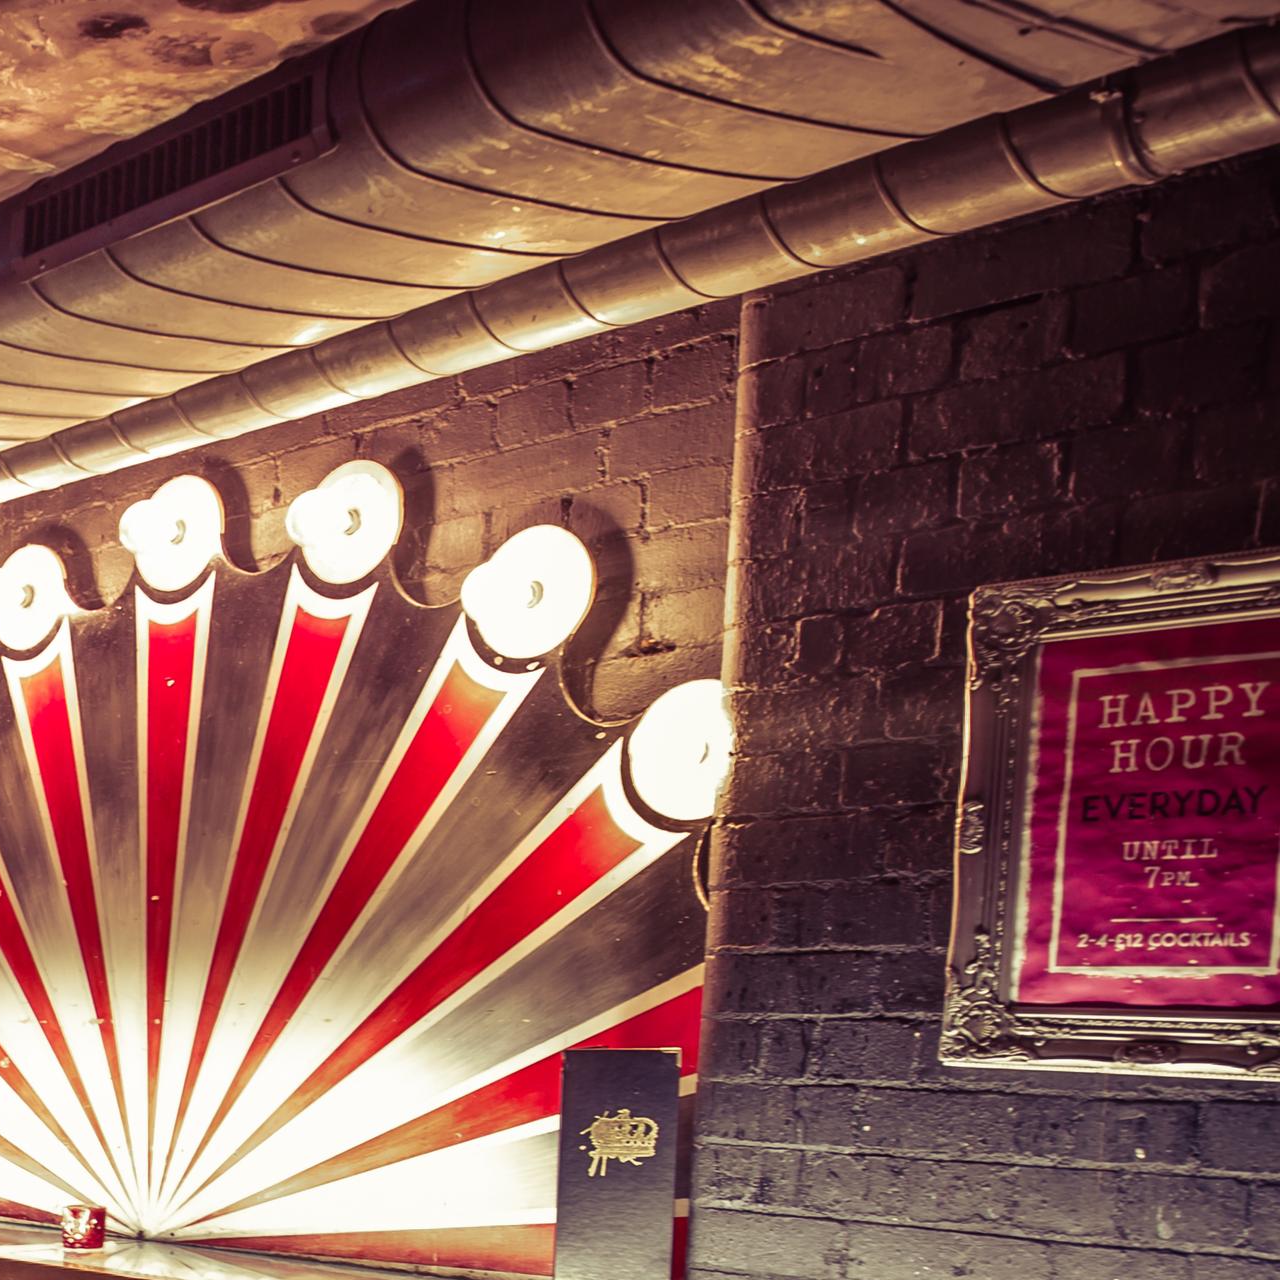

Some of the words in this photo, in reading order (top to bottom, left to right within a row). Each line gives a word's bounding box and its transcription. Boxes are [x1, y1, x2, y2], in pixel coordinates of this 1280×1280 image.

[1098, 681, 1271, 728] HAPPY
[1108, 731, 1247, 773] HOUR
[1082, 785, 1267, 822] EVERYDAY
[1122, 838, 1218, 861] UNTIL
[1148, 932, 1251, 949] COCKTAILS
